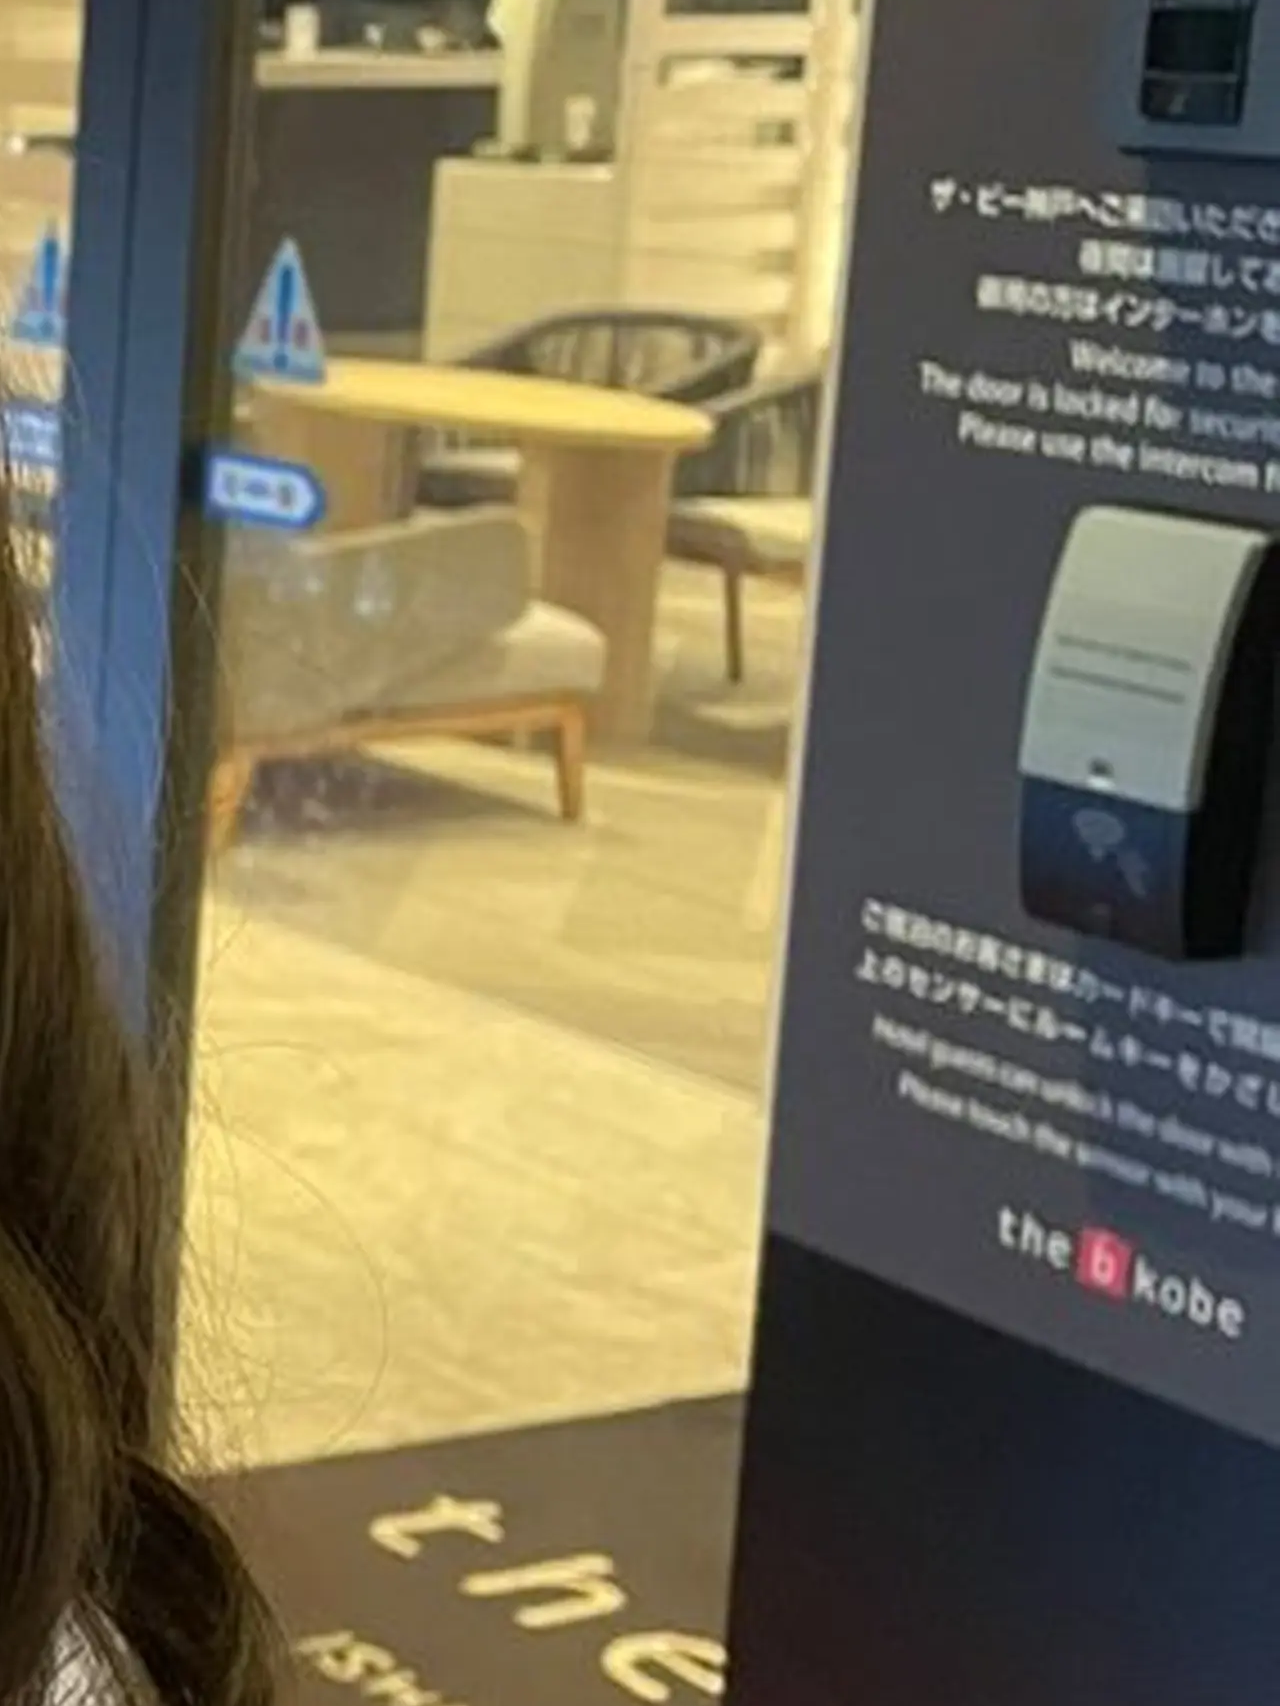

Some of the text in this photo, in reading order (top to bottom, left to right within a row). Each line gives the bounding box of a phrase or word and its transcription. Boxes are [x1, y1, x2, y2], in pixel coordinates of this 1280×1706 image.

[921, 360, 962, 398] The
[967, 372, 1023, 406] door
[1028, 381, 1048, 411] is
[1053, 382, 1138, 426] locked
[1144, 395, 1183, 430] for
[1070, 340, 1190, 385] Welcome
[1195, 361, 1225, 390] to
[958, 411, 1037, 452] Please
[1041, 433, 1086, 462] use
[1091, 435, 1134, 471] the
[1140, 443, 1258, 488] intercom
[899, 1068, 962, 1120] Please
[998, 1205, 1071, 1270] the
[1134, 1253, 1246, 1339] kobe
[368, 1495, 729, 1703] the
